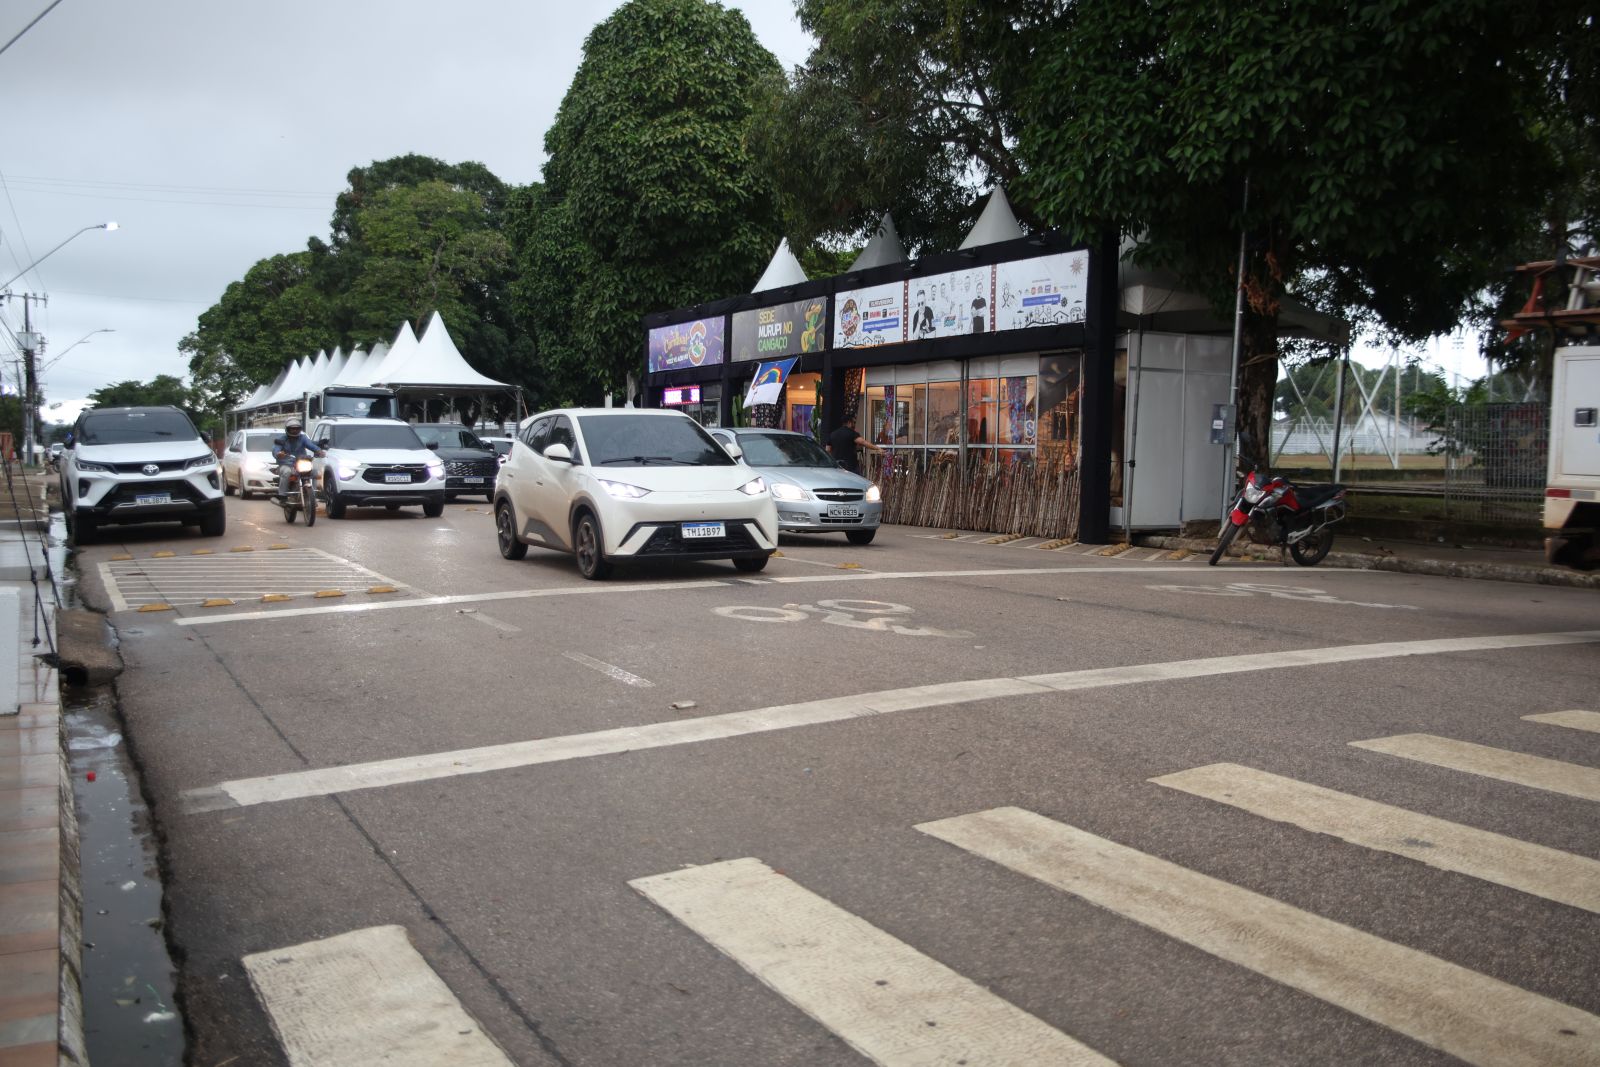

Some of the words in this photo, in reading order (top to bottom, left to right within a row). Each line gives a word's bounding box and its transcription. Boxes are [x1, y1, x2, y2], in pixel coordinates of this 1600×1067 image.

[759, 310, 775, 324] SEDE
[758, 322, 782, 338] MURUPI
[783, 321, 793, 335] NO
[758, 336, 788, 353] CANGAÇO
